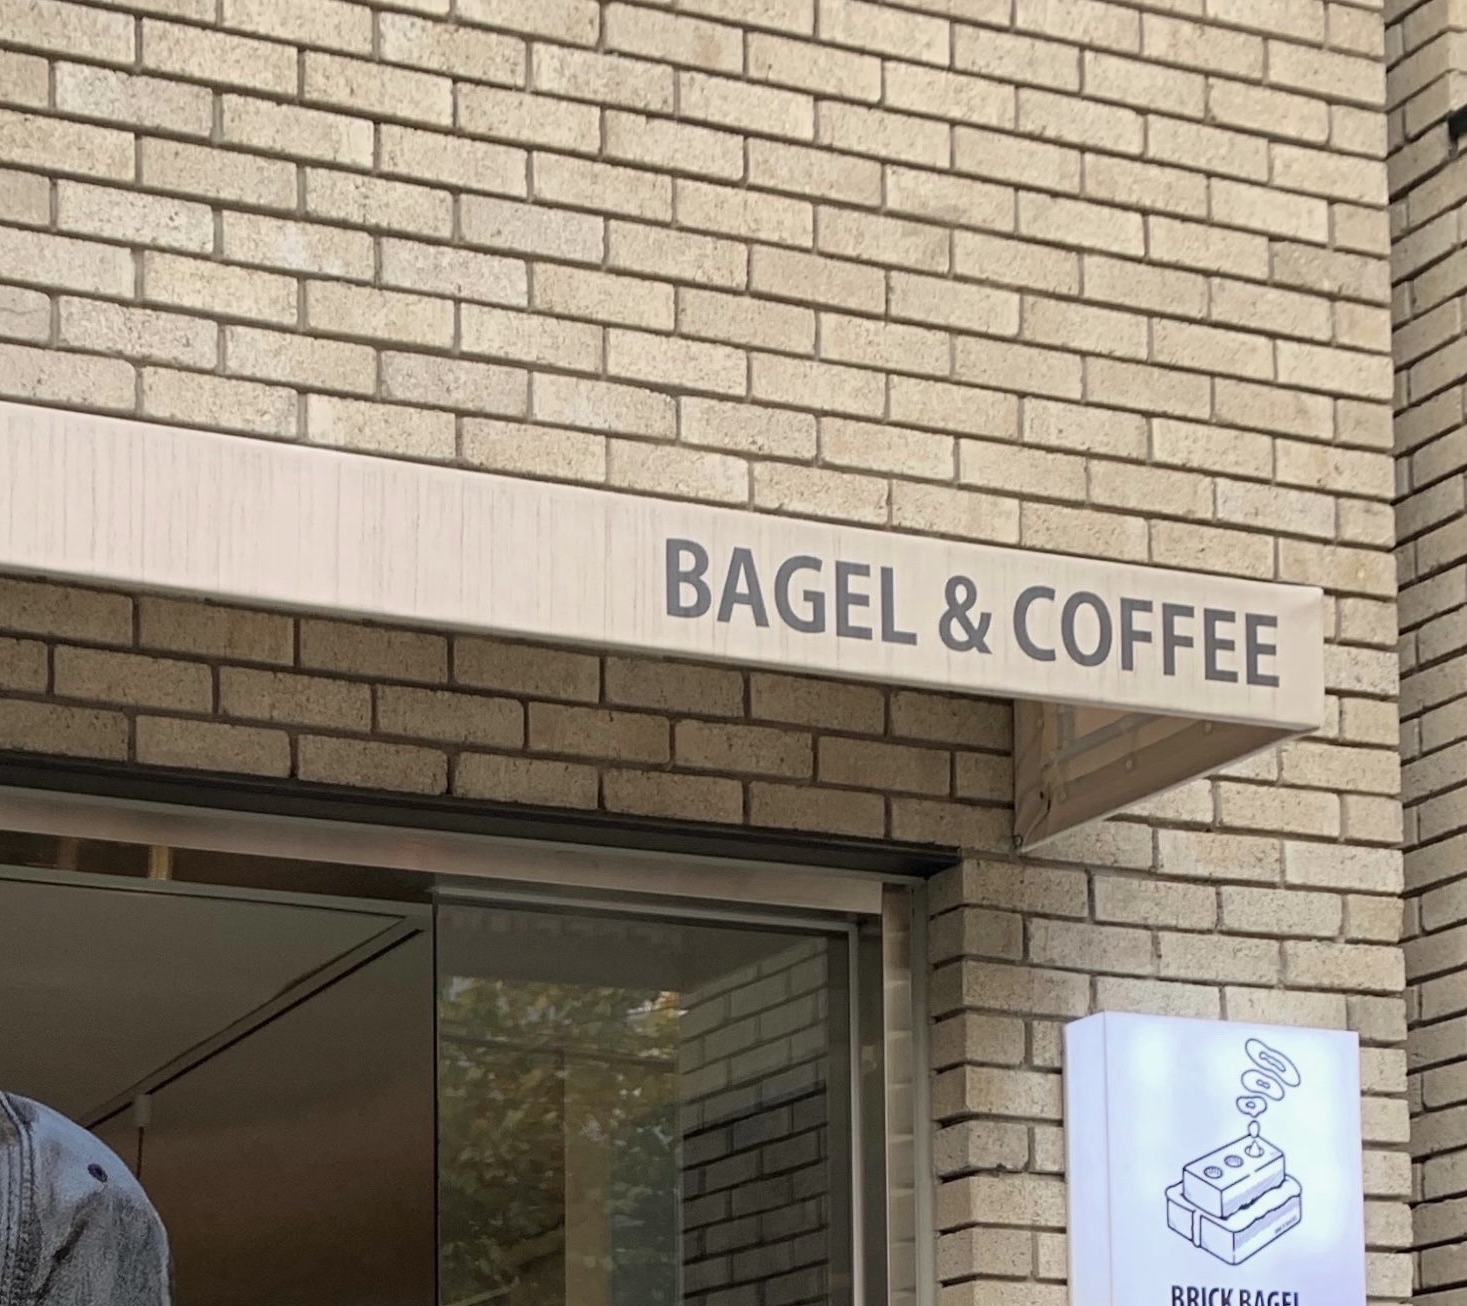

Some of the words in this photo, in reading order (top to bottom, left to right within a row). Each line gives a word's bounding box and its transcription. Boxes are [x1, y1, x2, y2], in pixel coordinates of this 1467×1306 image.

[664, 536, 919, 647] BAGEL
[939, 575, 992, 655] &
[1013, 584, 1281, 689] COFFEE
